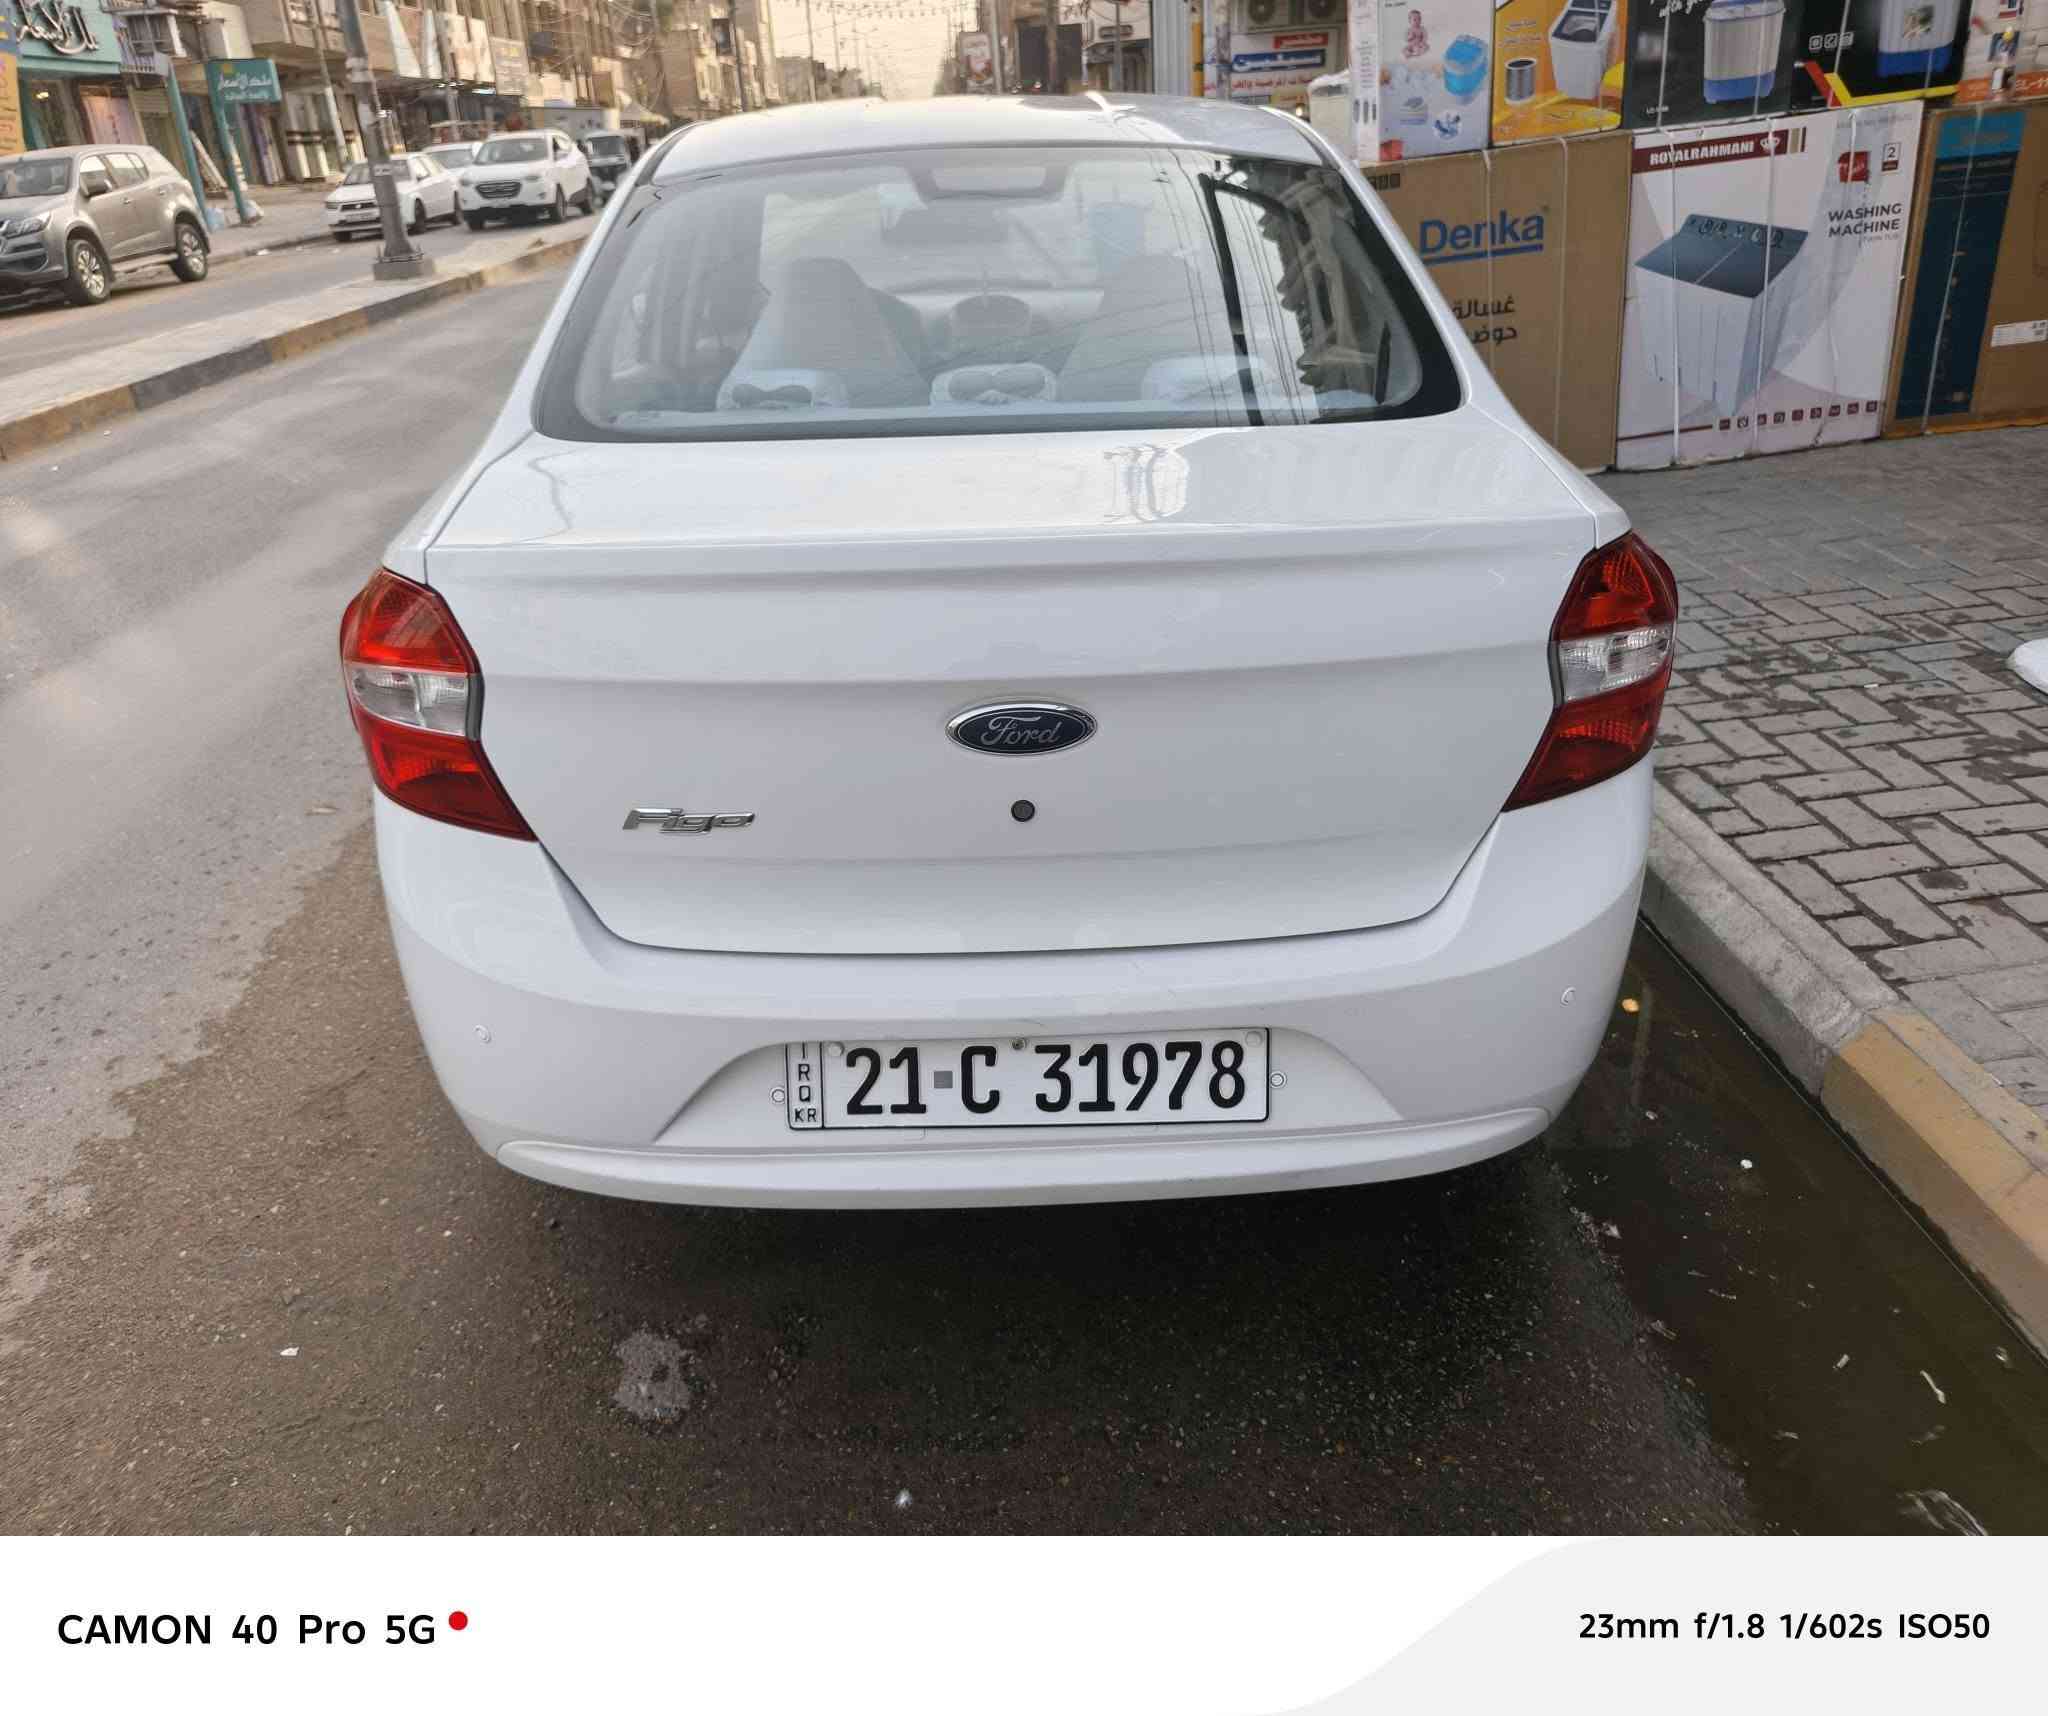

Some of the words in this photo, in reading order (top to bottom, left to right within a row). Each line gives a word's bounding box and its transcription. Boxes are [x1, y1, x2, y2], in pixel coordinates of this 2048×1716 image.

[1650, 141, 1754, 165] ROYALRAHMANI
[1887, 146, 1896, 159] 2
[1828, 203, 1903, 222] WASHING
[1419, 208, 1544, 256] Denka
[1828, 218, 1901, 238] MACHINE
[981, 715, 1063, 746] Ford
[622, 807, 755, 834] Figo
[846, 1047, 927, 1115] 21
[960, 1045, 1000, 1114] C
[1034, 1040, 1246, 1113] 31978
[794, 1108, 817, 1122] KR
